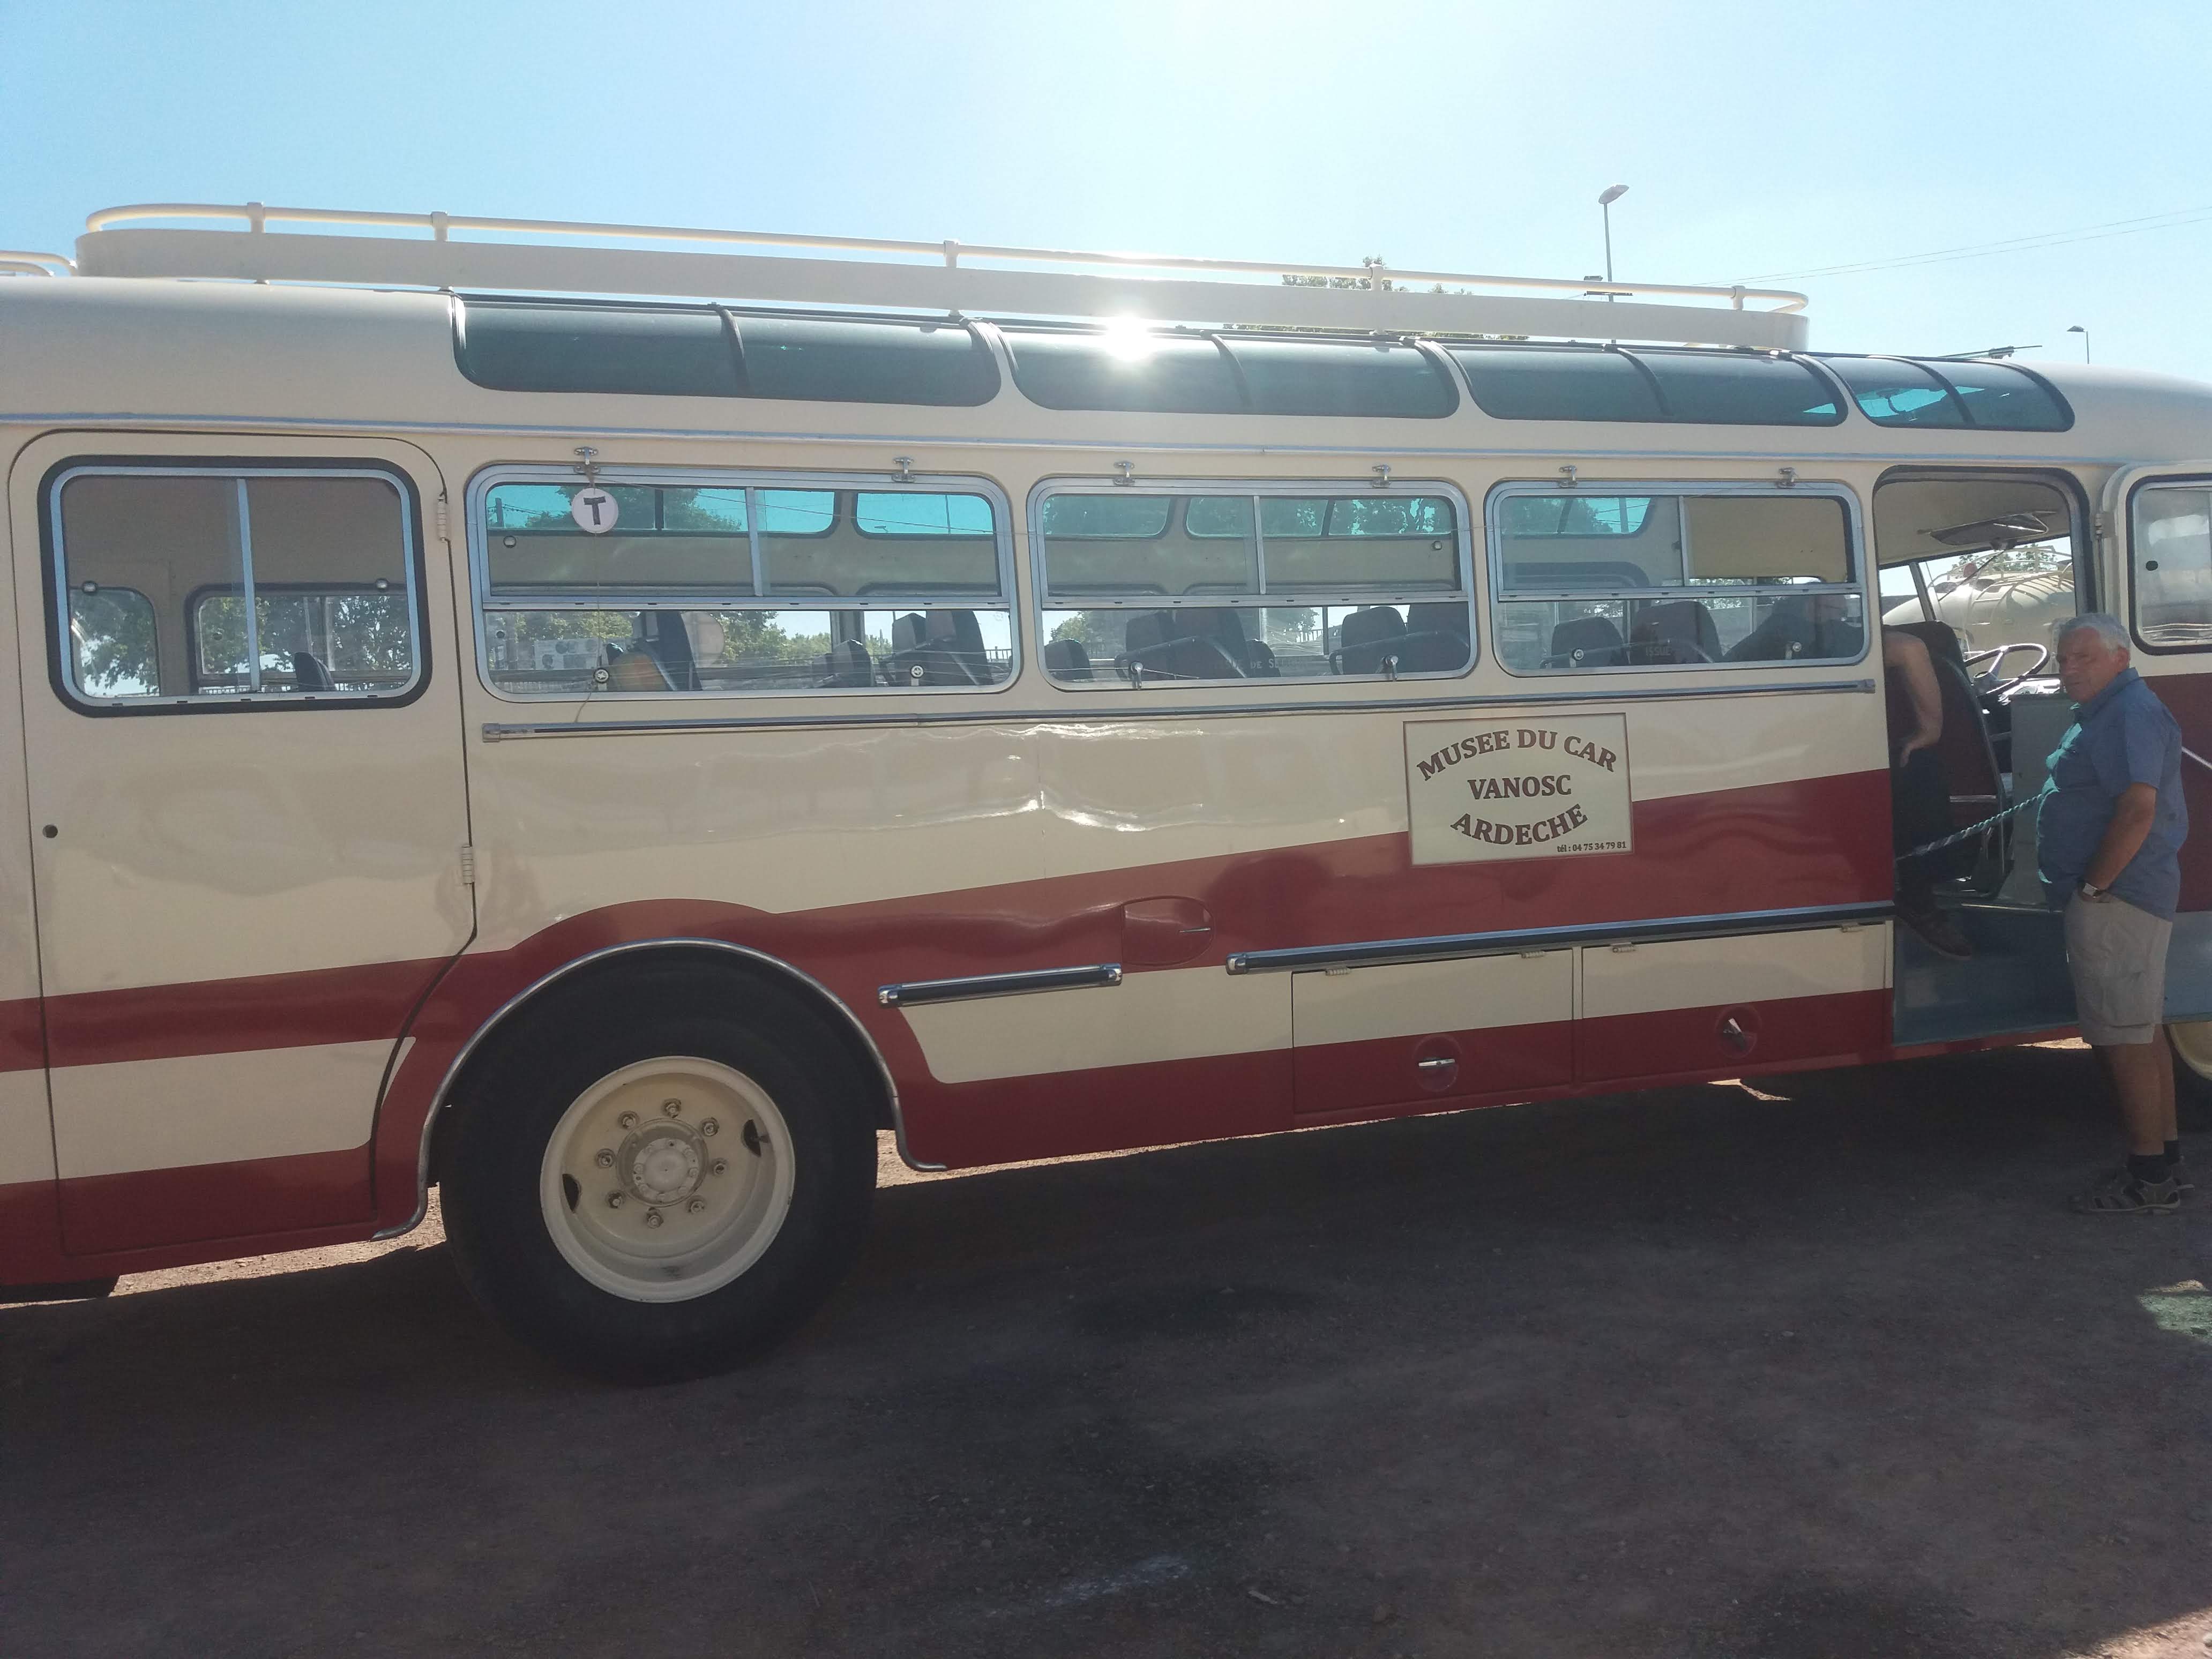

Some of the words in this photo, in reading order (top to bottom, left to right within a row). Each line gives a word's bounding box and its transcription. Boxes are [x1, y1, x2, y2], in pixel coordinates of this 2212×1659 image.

[583, 496, 606, 525] T
[1416, 730, 1510, 781] MUSEE
[1516, 729, 1558, 750] DU
[1564, 736, 1617, 773] CAR
[1467, 775, 1572, 799] VANOSC
[1450, 803, 1588, 846] ARDECHE
[1583, 843, 1594, 851] 75
[1595, 842, 1604, 850] 34
